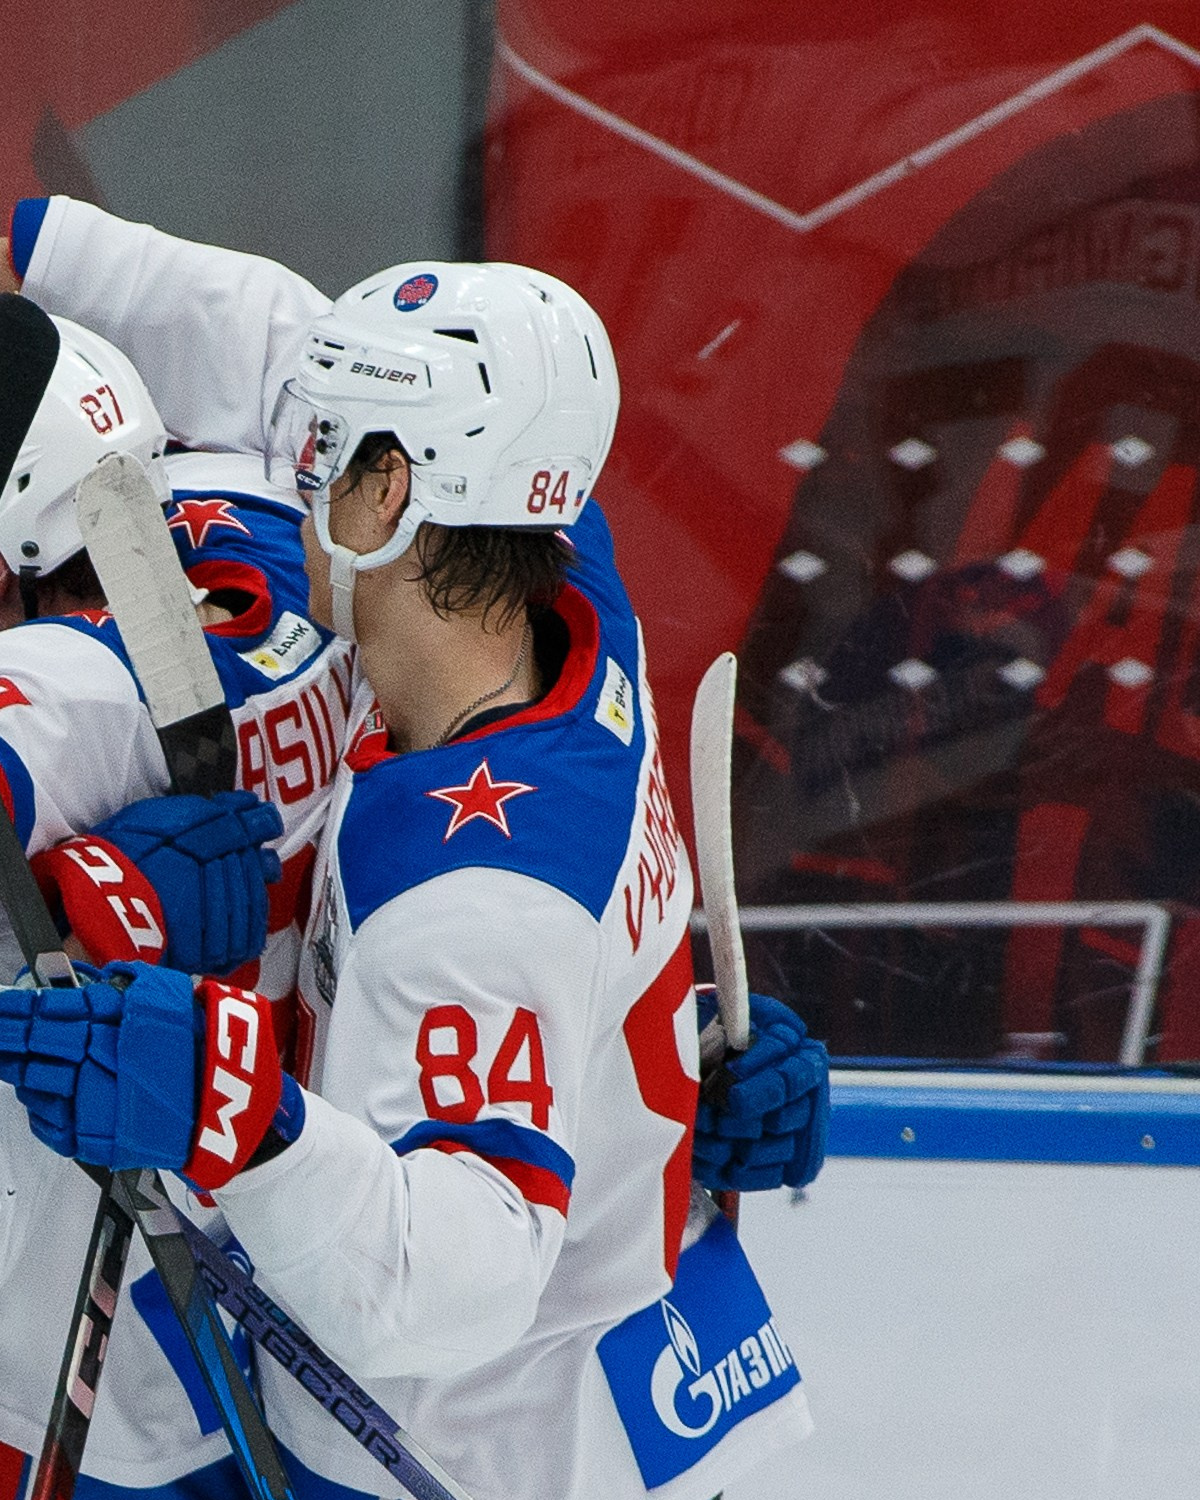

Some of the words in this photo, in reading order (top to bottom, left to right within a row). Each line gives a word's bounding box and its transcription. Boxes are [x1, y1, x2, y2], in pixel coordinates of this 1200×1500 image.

[350, 362, 417, 386] BAUER
[528, 470, 568, 514] 84
[198, 983, 259, 1165] CM
[415, 1004, 554, 1131] 84
[197, 1262, 401, 1468] RIBCOR
